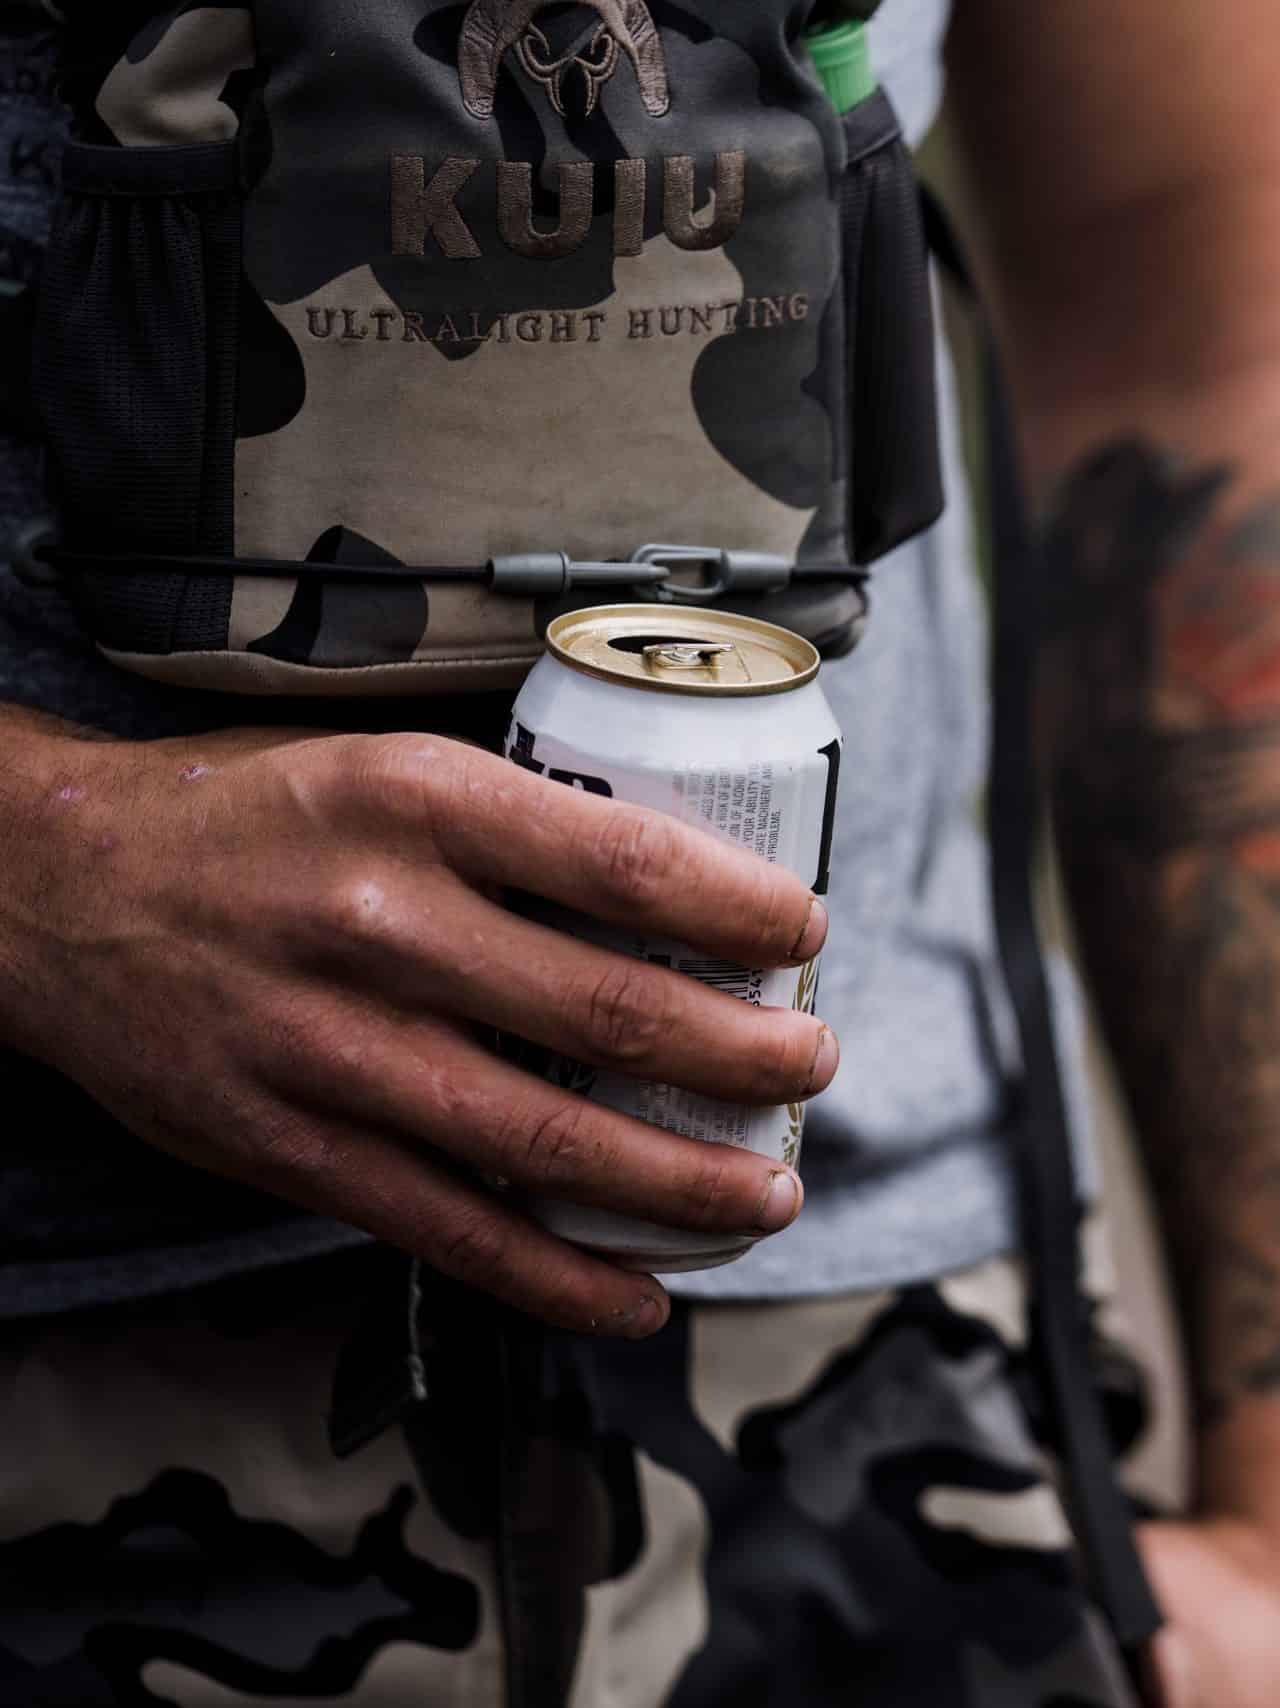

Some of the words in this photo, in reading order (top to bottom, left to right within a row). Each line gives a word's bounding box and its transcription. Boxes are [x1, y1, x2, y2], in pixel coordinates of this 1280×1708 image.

[391, 150, 745, 259] KUIU
[305, 306, 606, 344] ULTRALIGHT
[627, 295, 810, 340] HUNTING
[744, 781, 760, 815] ABILITY
[741, 817, 755, 843] YOUR
